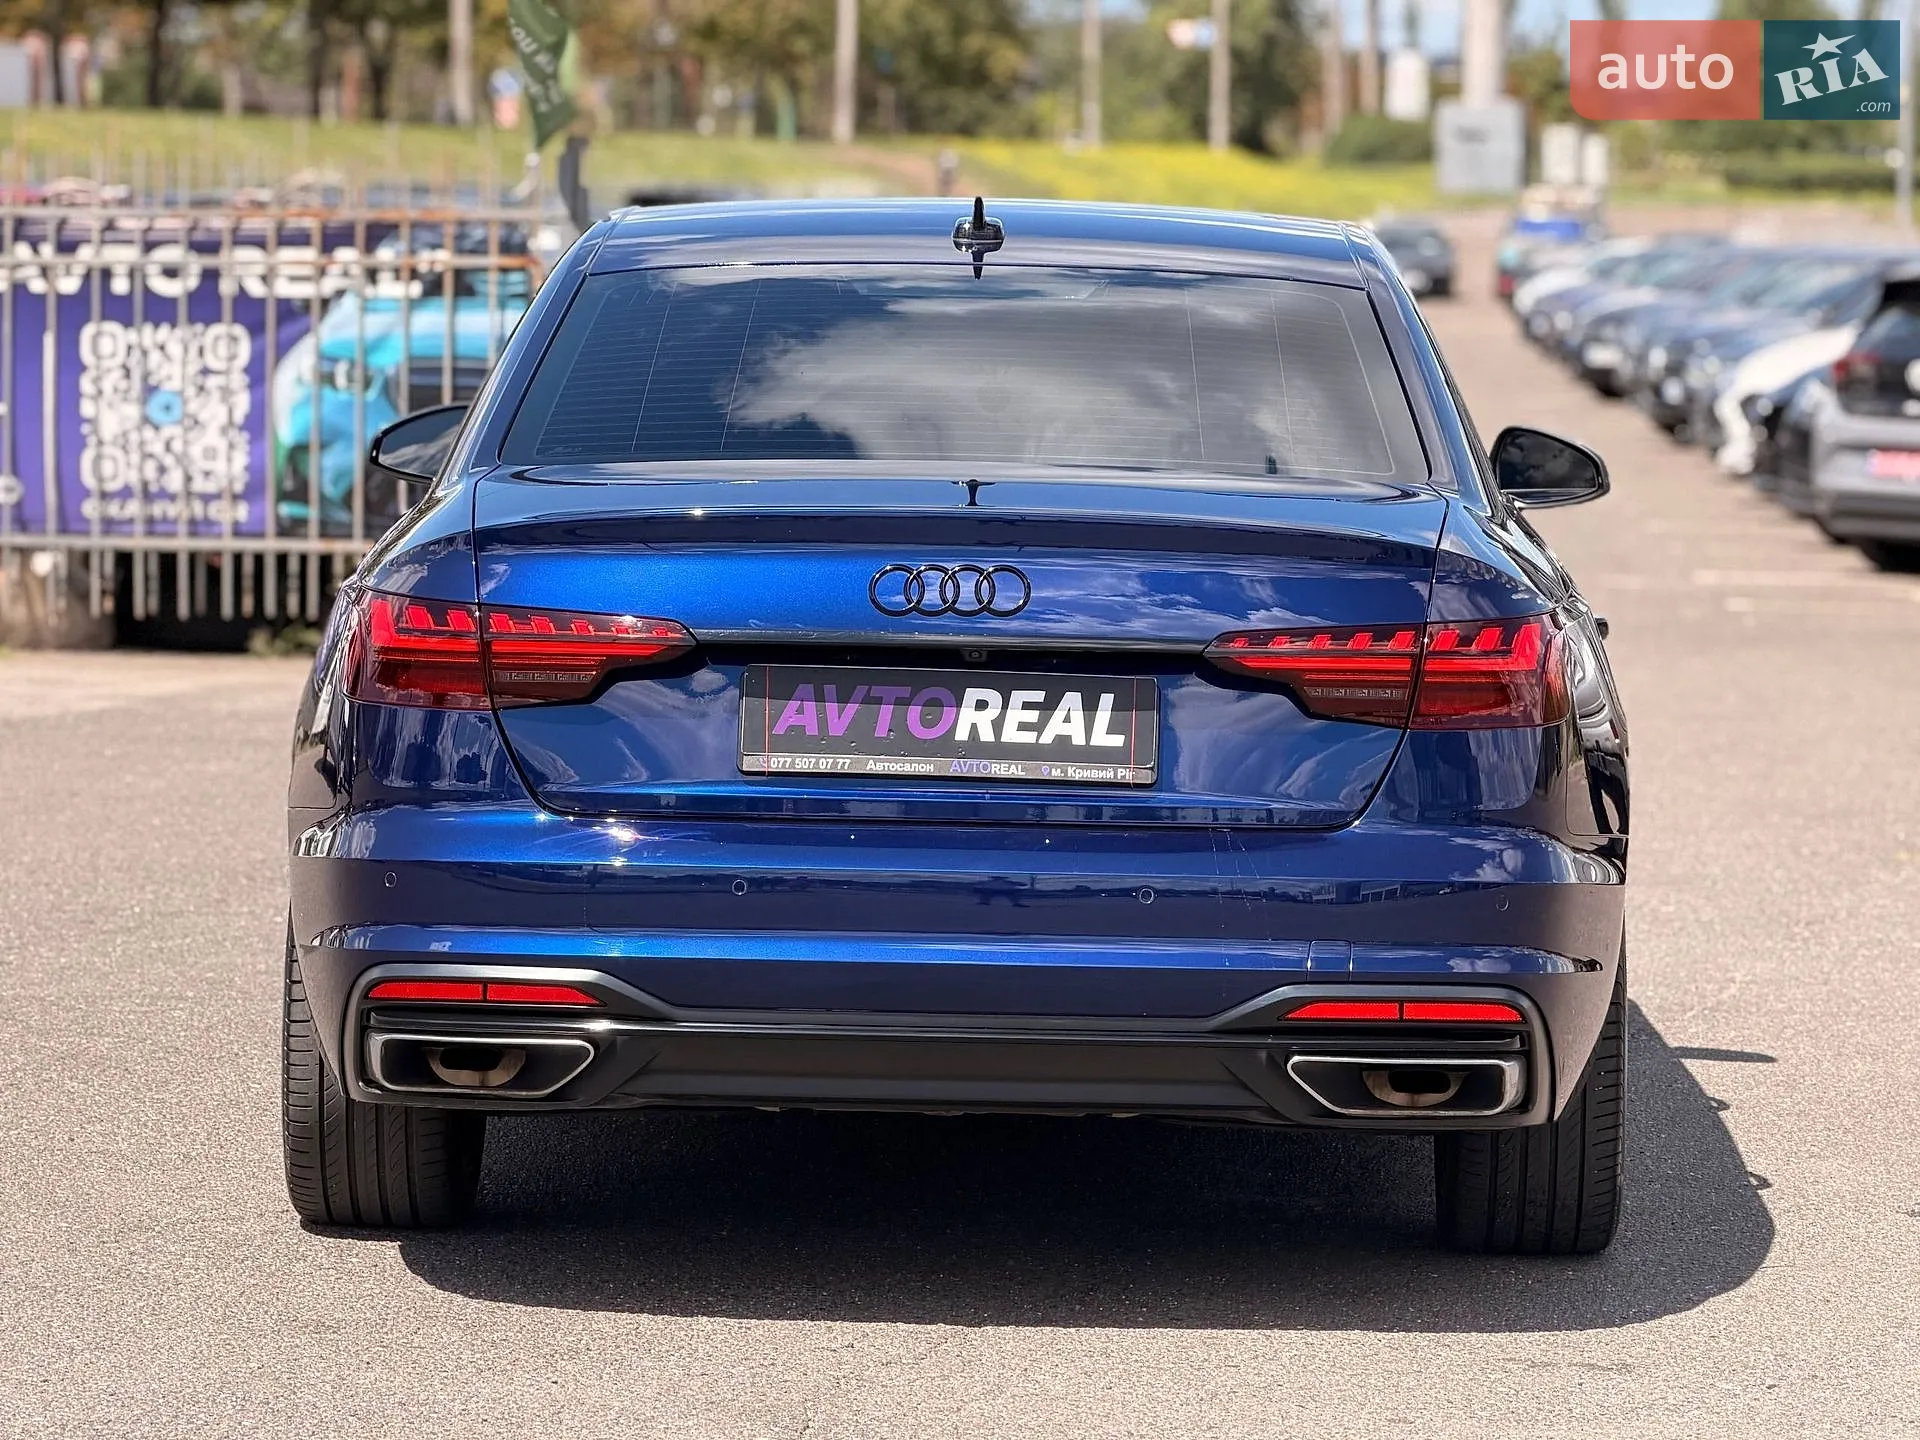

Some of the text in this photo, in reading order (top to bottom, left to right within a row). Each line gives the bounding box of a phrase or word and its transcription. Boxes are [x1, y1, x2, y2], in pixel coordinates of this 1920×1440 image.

[770, 757, 790, 769] 077
[794, 757, 815, 770] 507
[819, 758, 833, 770] 07
[837, 759, 851, 770] 77
[866, 759, 934, 773] Автосалон
[1067, 766, 1114, 780] Кривий
